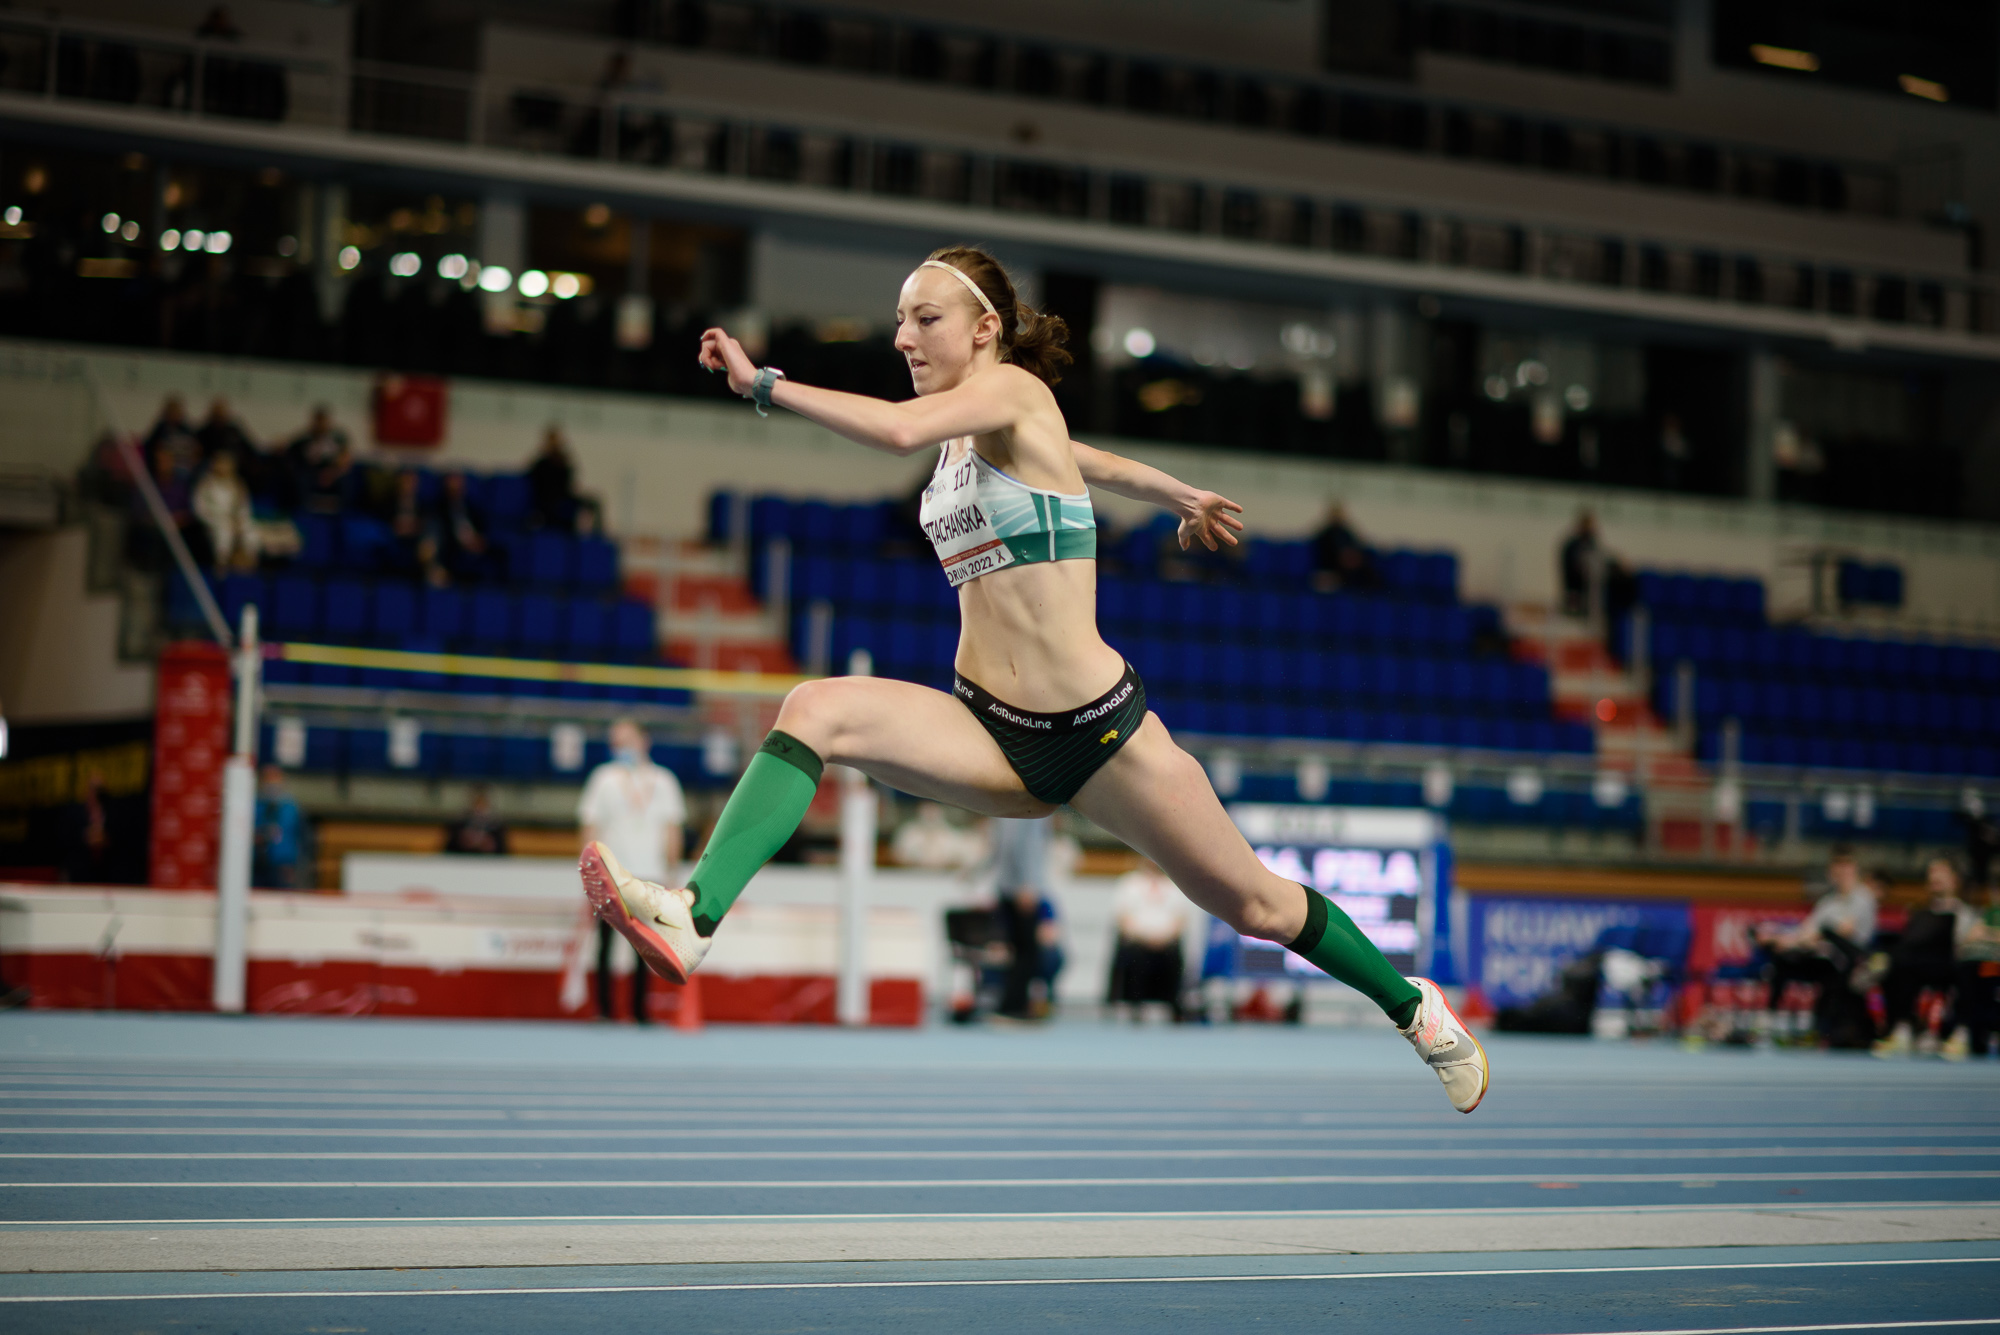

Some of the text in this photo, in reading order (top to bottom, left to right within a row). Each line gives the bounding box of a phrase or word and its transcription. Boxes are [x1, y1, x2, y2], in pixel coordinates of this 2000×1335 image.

[954, 462, 971, 491] 117
[969, 556, 994, 575] 2022
[1423, 1012, 1440, 1046] NIKE
